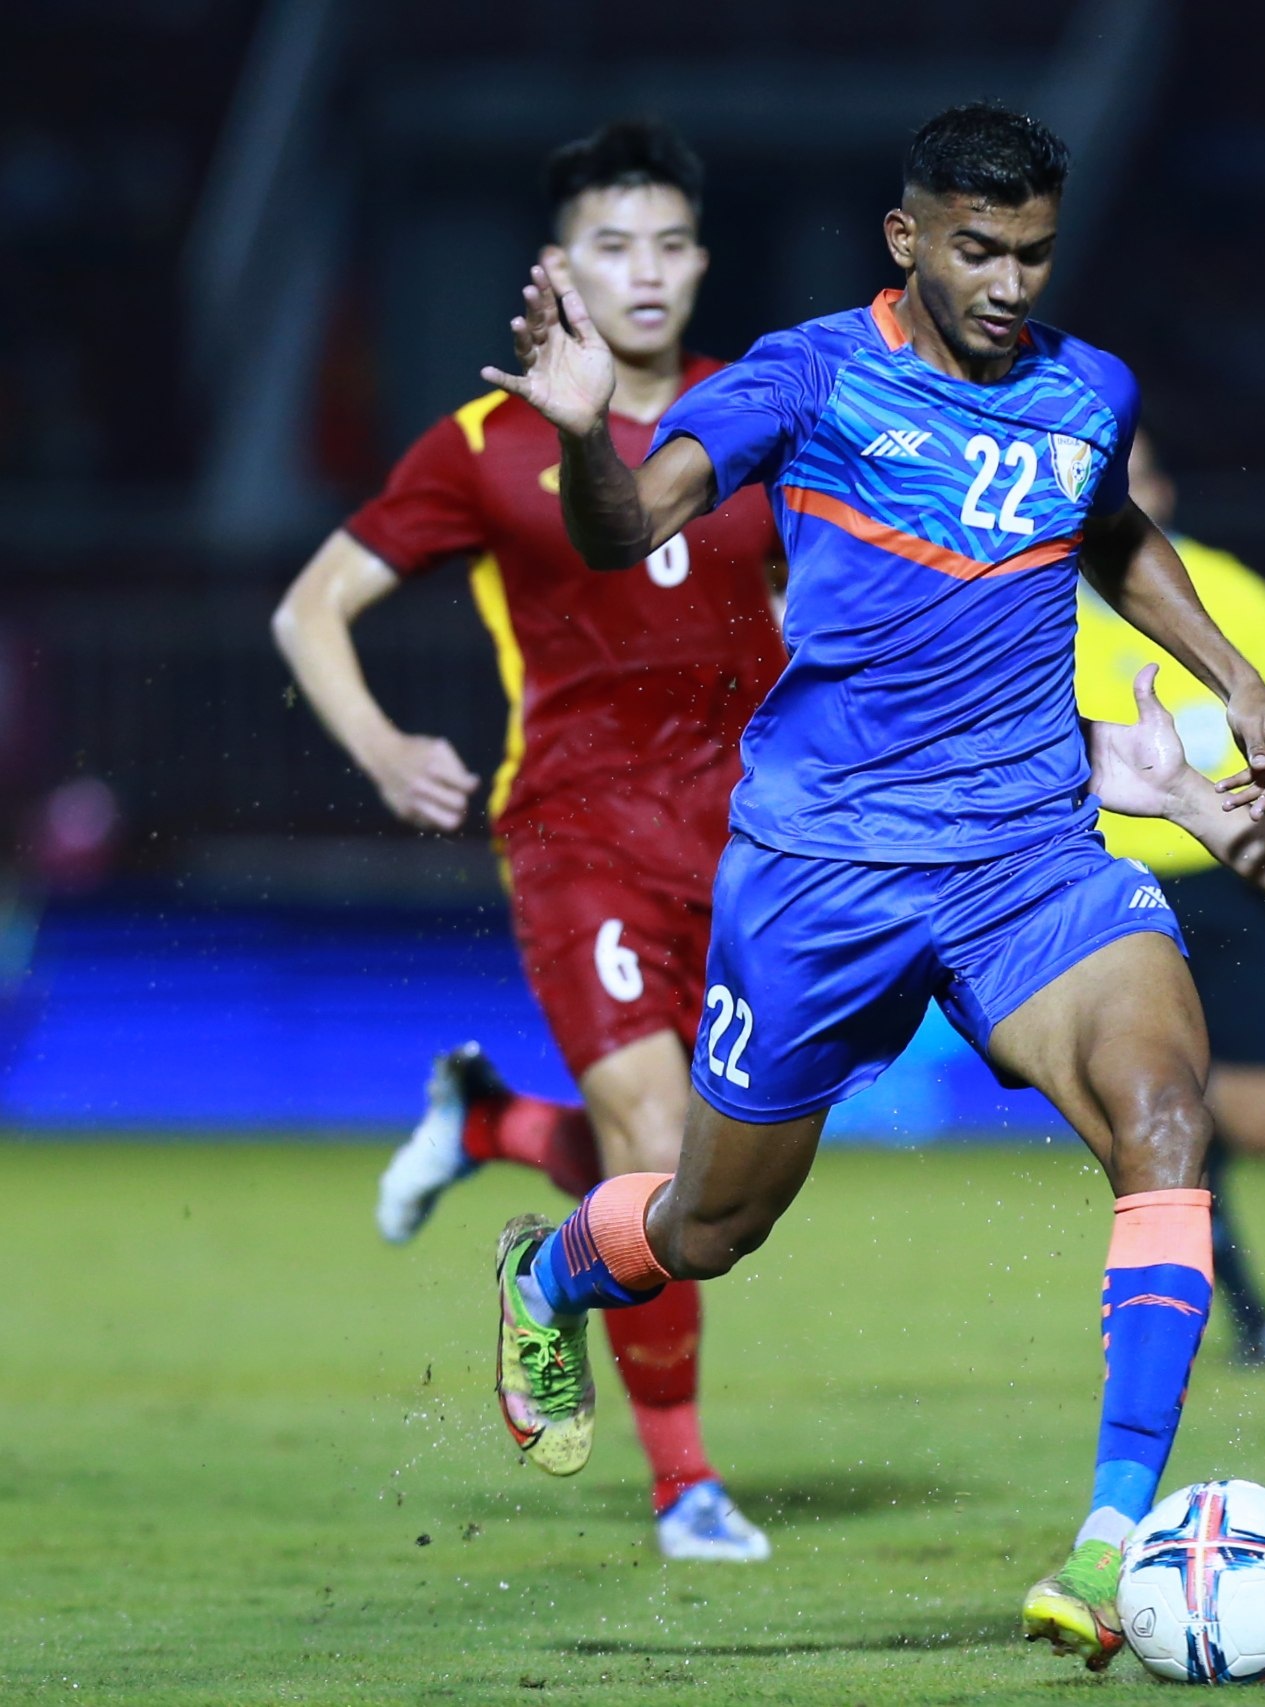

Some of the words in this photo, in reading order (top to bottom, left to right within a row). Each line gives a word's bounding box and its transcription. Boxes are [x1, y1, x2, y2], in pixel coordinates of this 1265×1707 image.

[960, 434, 1038, 535] 22
[594, 917, 644, 1003] 6
[706, 983, 753, 1089] 22
